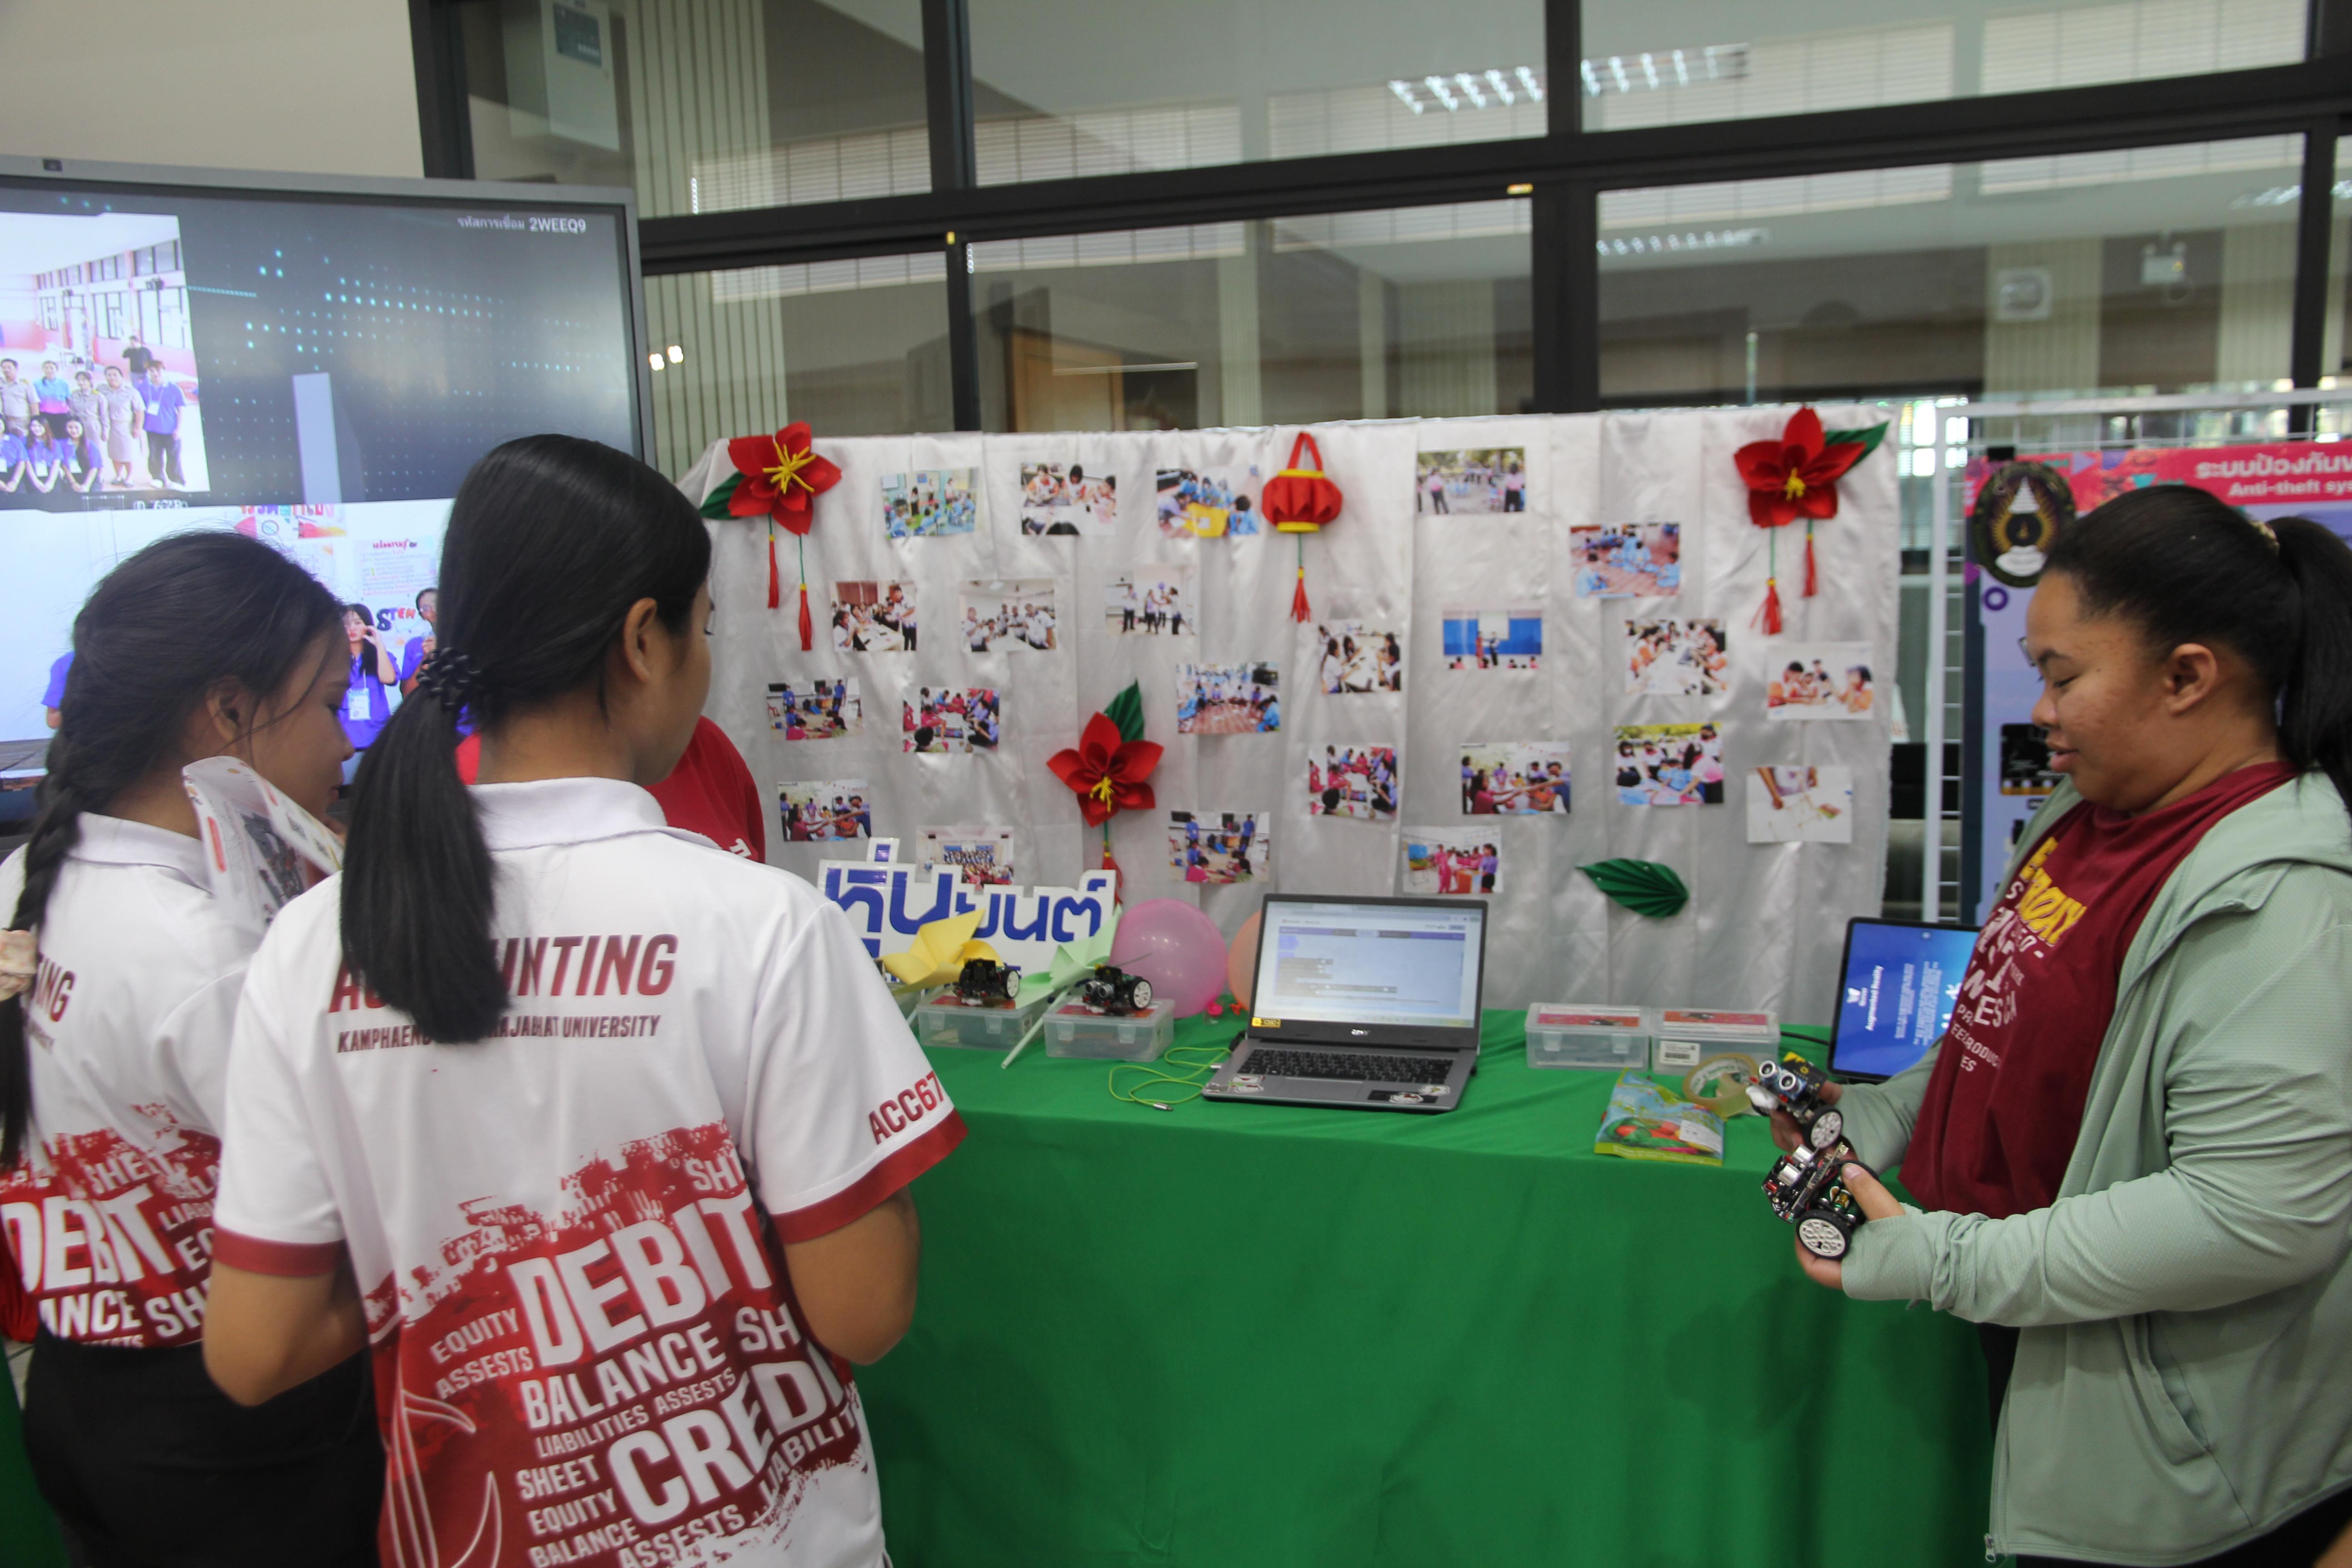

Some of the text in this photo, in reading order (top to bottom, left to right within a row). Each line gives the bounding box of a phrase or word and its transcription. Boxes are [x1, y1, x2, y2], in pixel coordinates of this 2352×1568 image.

[529, 217, 586, 235] 2WEEQ9
[2228, 479, 2352, 496] Anti-theft sys
[328, 933, 680, 1014] AUNTING
[337, 1024, 431, 1053] KAMPHAEN
[563, 1015, 662, 1038] UNIVERSITY
[868, 1070, 944, 1145] ACC67
[0, 1183, 176, 1293] DEBIT
[507, 1189, 772, 1367] DEBIT
[430, 1307, 519, 1364] EQUITY
[436, 1346, 534, 1400] ASSESTS
[520, 1321, 727, 1430] BALANCE
[535, 1367, 736, 1459] LIABILITIES ASSESTS
[608, 1337, 844, 1524] CREDI
[516, 1454, 600, 1501] SHEET
[528, 1488, 618, 1536] EQUITY
[617, 1504, 746, 1568] ASSESTS
[529, 1518, 640, 1568] BALANCE
